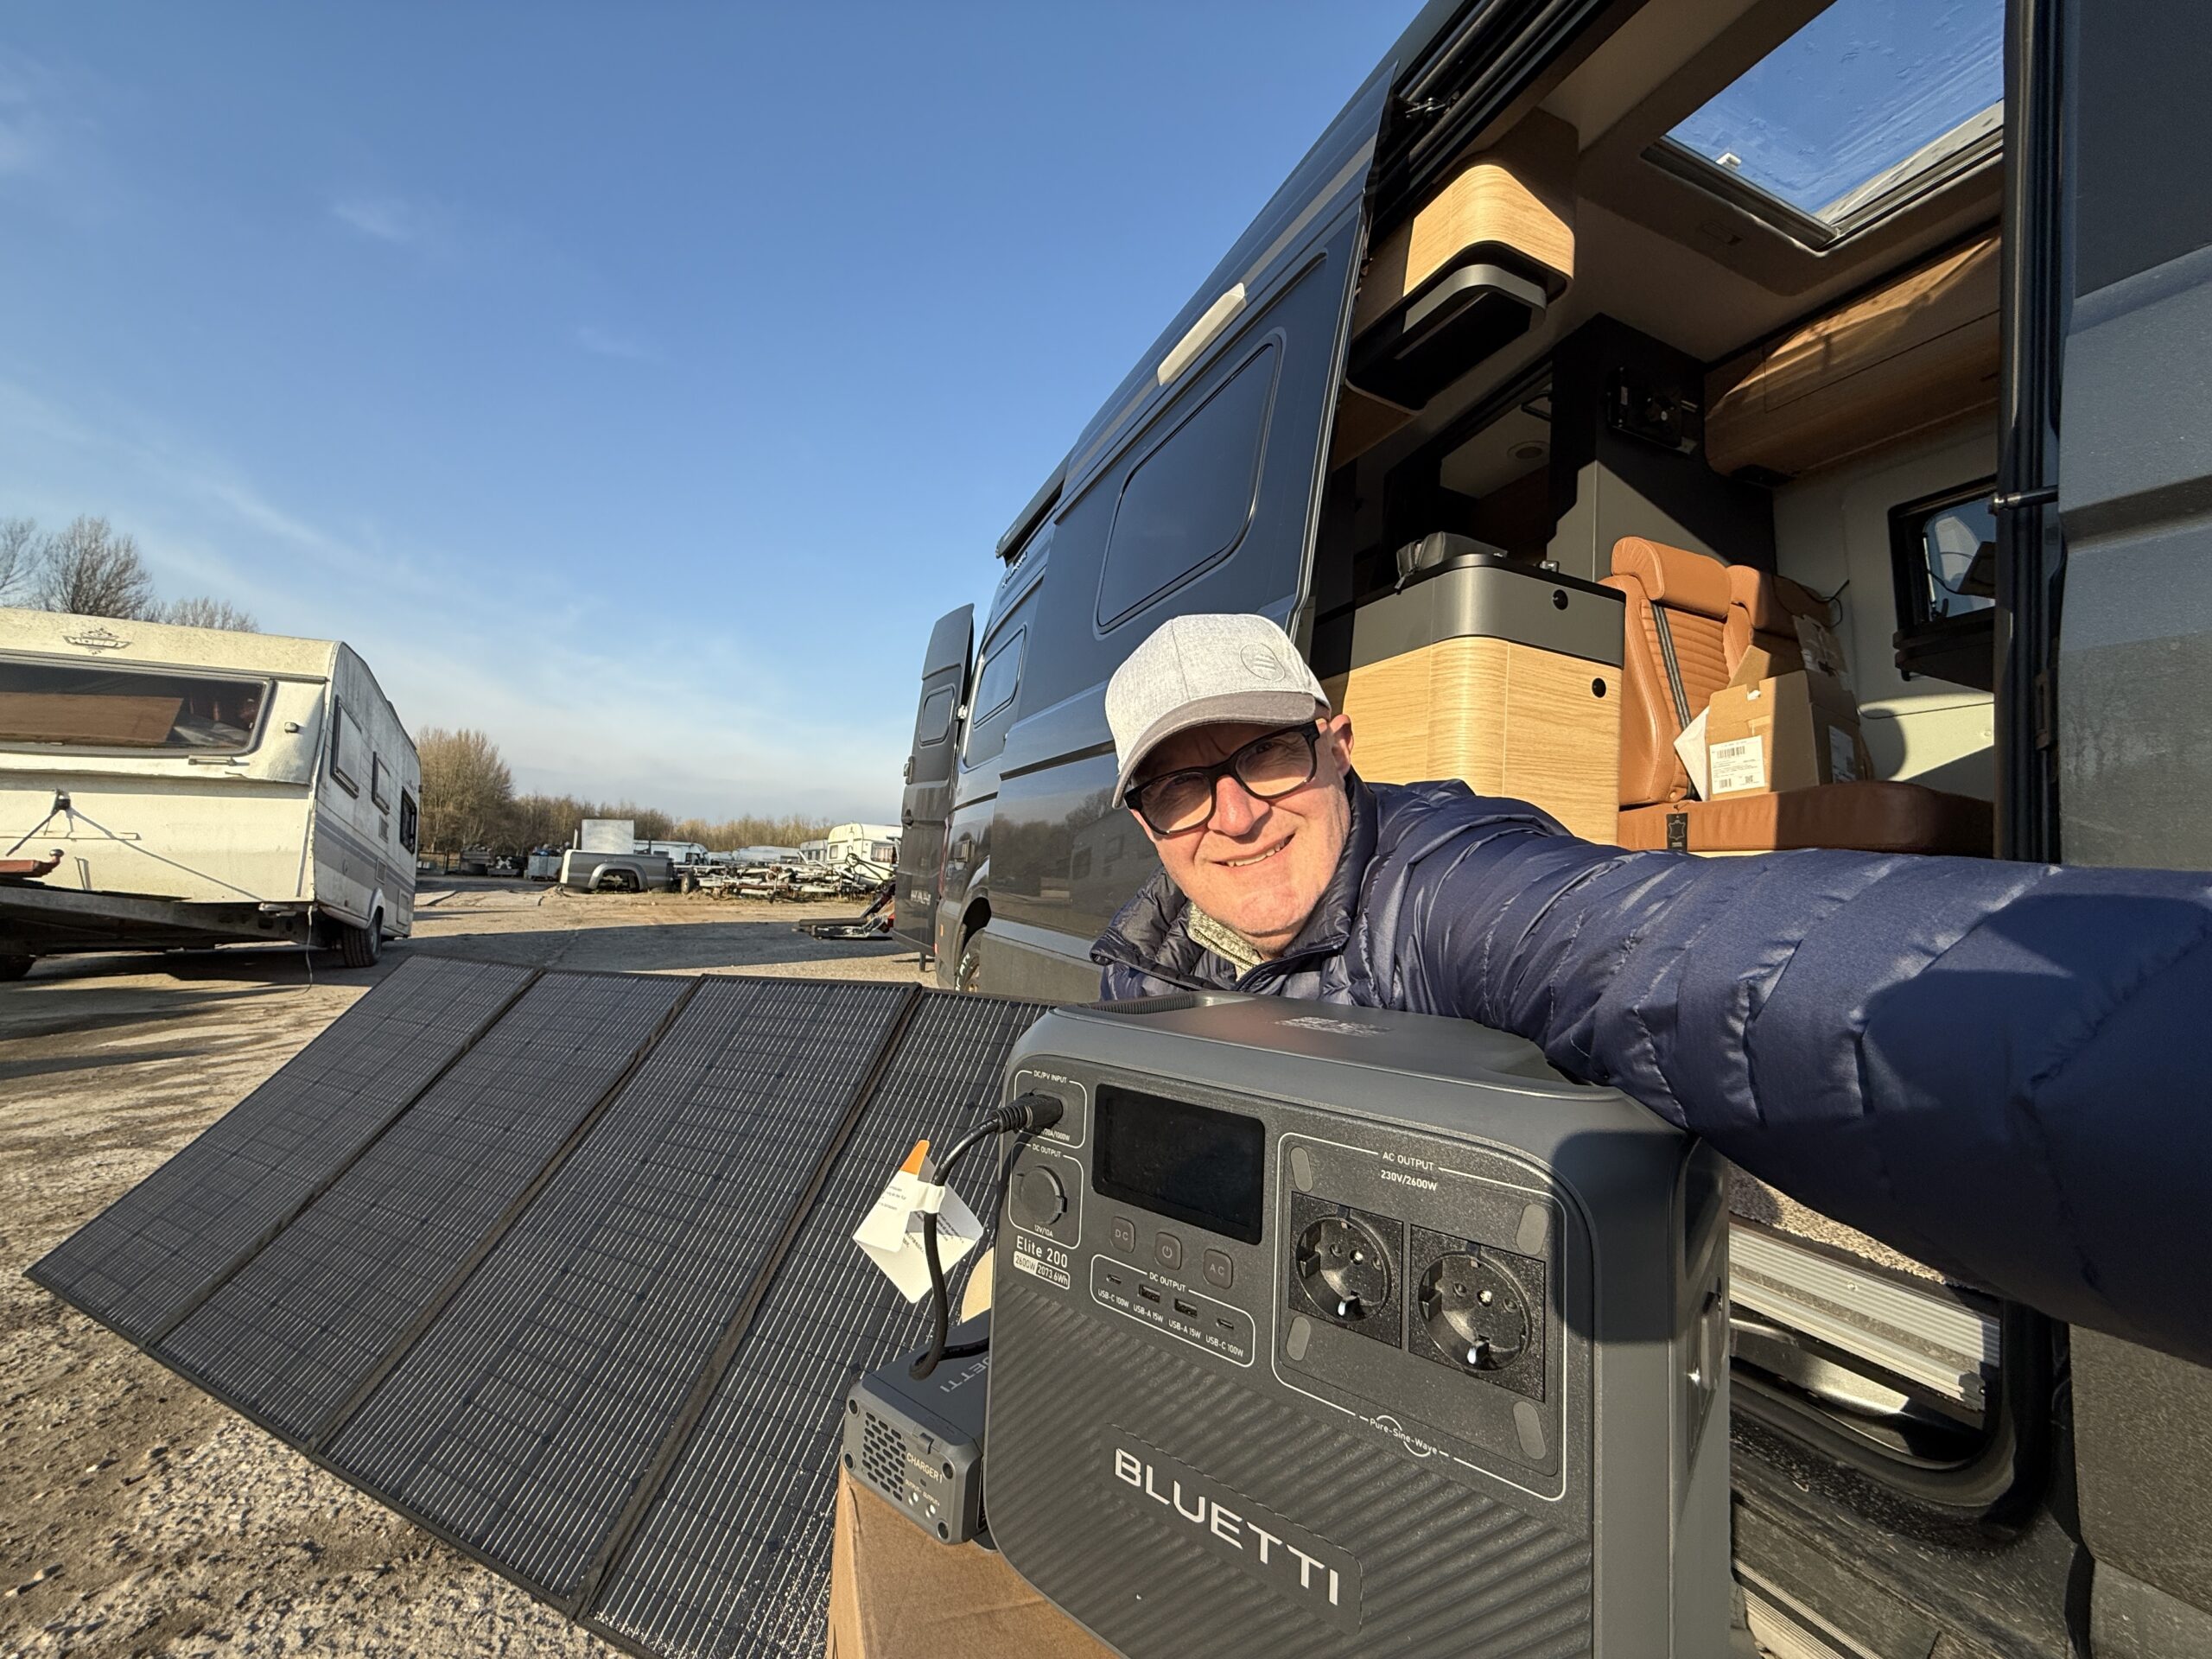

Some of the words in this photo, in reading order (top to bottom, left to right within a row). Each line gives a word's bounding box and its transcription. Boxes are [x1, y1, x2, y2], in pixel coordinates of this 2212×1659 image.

[1033, 1070, 1051, 1080] DC/PV
[1051, 1075, 1068, 1084] INPUT
[1033, 1143, 1040, 1152] DC
[1040, 1146, 1062, 1158] OUTPUT
[1382, 1151, 1395, 1162] AC
[1397, 1154, 1435, 1171] OUTPUT
[1380, 1169, 1438, 1192] 230V/2600W
[1033, 1224, 1053, 1237] 12V/10A
[1115, 1229, 1128, 1241] DC
[1016, 1235, 1043, 1257] Elite
[1046, 1248, 1068, 1268] 200
[1015, 1255, 1036, 1271] 2600W
[1037, 1264, 1068, 1286] 2073.6Wh
[1210, 1263, 1224, 1275] AC
[1148, 1271, 1159, 1282] DC
[1160, 1275, 1186, 1293] OUTPUT
[1097, 1288, 1116, 1303] USB-C
[1116, 1295, 1129, 1308] 100W
[1133, 1303, 1152, 1319] USB-A
[1152, 1312, 1164, 1324] 15W
[1168, 1319, 1188, 1334] USB-A
[1189, 1327, 1202, 1339] 15W
[1205, 1334, 1227, 1351] USB-C
[1227, 1344, 1244, 1357] 100W
[1370, 1418, 1438, 1454] Pure-Sine-Wave
[906, 1452, 939, 1482] CHARGER
[1116, 1447, 1338, 1606] BLUETTI
